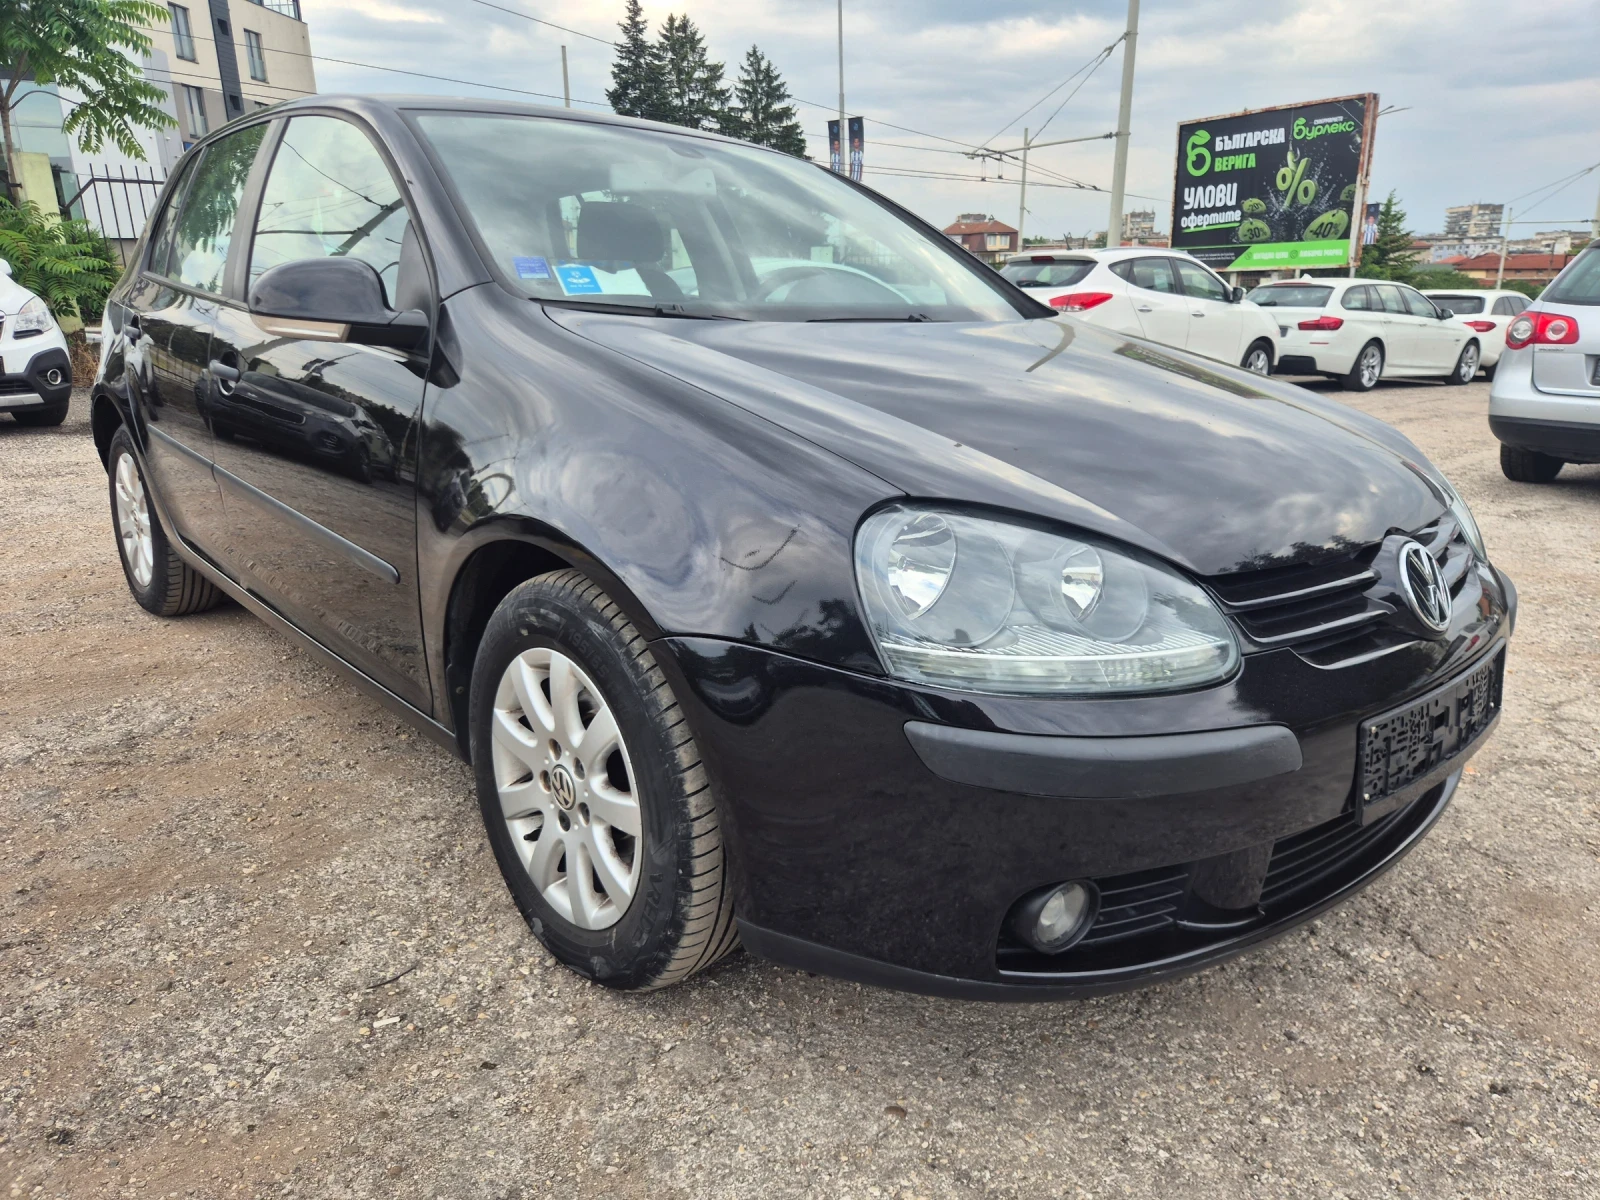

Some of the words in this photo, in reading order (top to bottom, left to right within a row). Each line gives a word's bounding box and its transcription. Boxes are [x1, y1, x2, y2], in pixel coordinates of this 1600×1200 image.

[1215, 127, 1286, 152] БЪЛГАРСКА
[1214, 153, 1256, 172] ВЕРИГА
[1183, 182, 1238, 210] УЛОВИ
[1180, 210, 1242, 230] офертите
[1243, 227, 1268, 240] -30%
[1309, 221, 1341, 239] -40%
